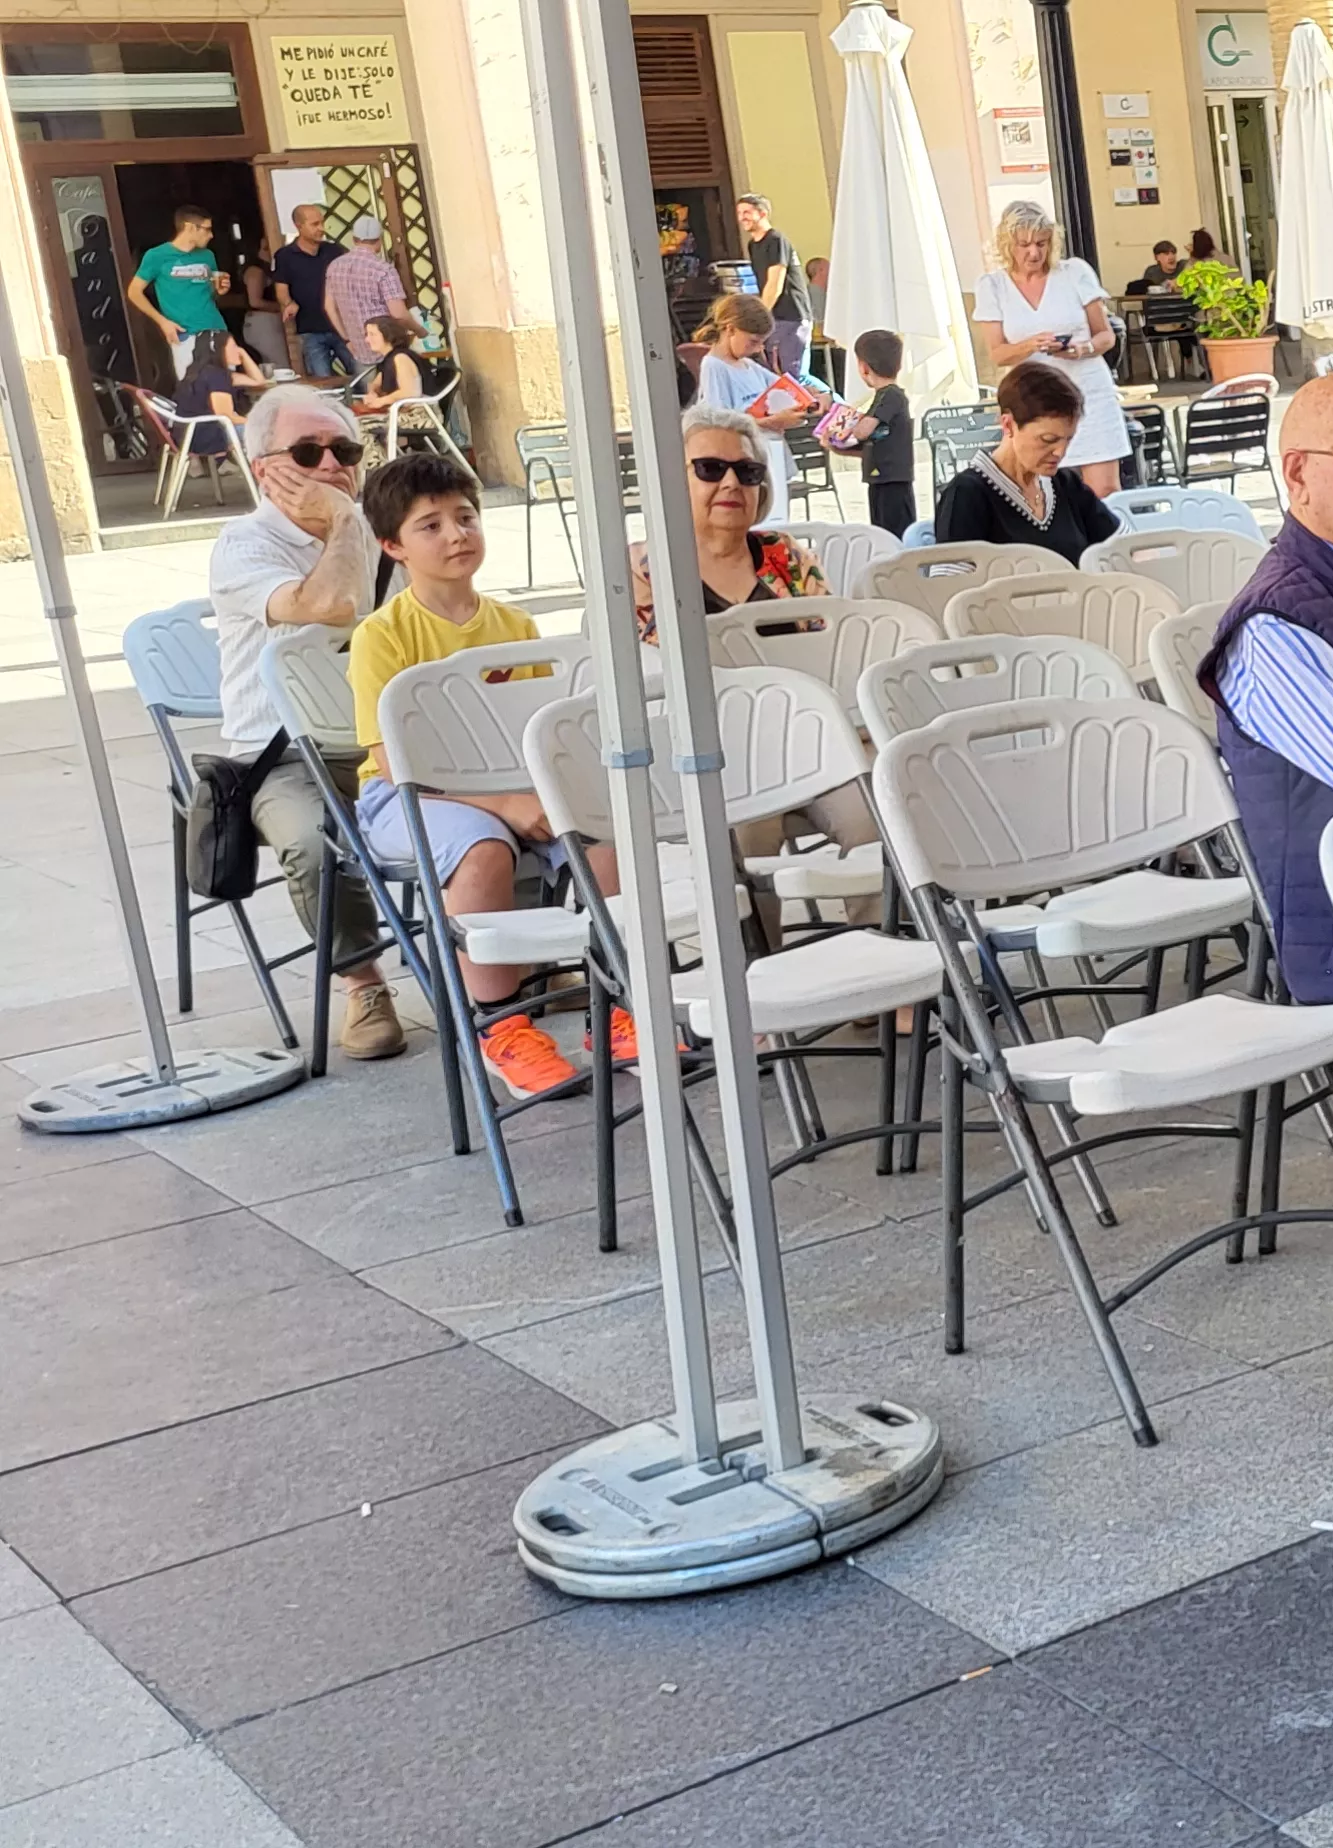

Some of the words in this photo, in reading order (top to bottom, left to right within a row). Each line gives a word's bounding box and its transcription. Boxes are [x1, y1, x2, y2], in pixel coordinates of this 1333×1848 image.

[280, 46, 304, 61] ME
[307, 43, 334, 60] PIDIÓ
[340, 46, 355, 58] UN
[357, 40, 388, 58] CAFÉ
[284, 67, 294, 82] Y
[301, 67, 316, 81] LE
[362, 65, 394, 79] SOLO
[328, 102, 392, 121] HERMOSO!
